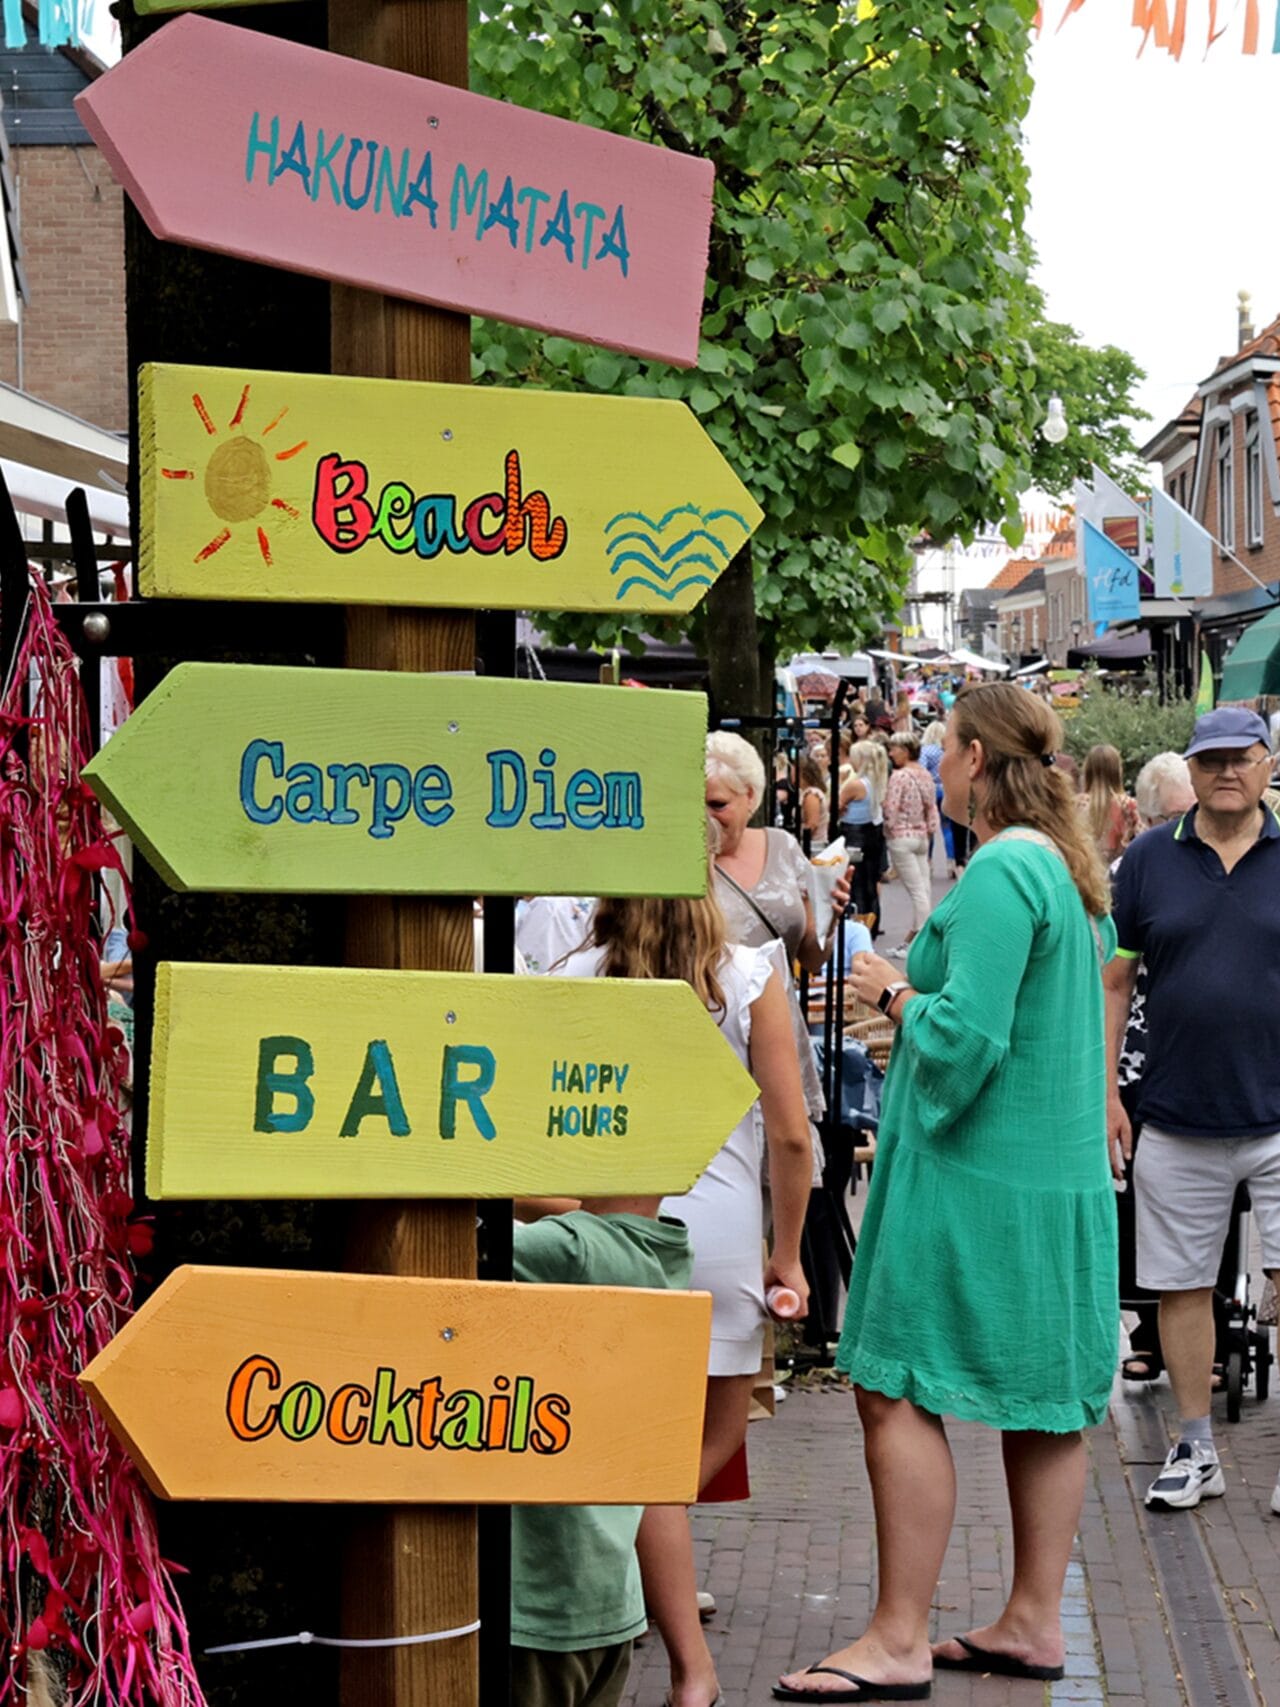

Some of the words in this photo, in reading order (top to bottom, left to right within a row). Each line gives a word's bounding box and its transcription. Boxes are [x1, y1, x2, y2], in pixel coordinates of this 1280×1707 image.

[245, 110, 438, 228] HAKUNA
[450, 163, 631, 278] MATATA
[311, 448, 568, 562] Beach
[240, 738, 453, 839] Carpe
[485, 747, 645, 830] Diem
[254, 1035, 497, 1140] BAR
[548, 1104, 628, 1137] HOURS
[551, 1059, 630, 1093] HAPPY
[225, 1354, 571, 1455] Cocktails
